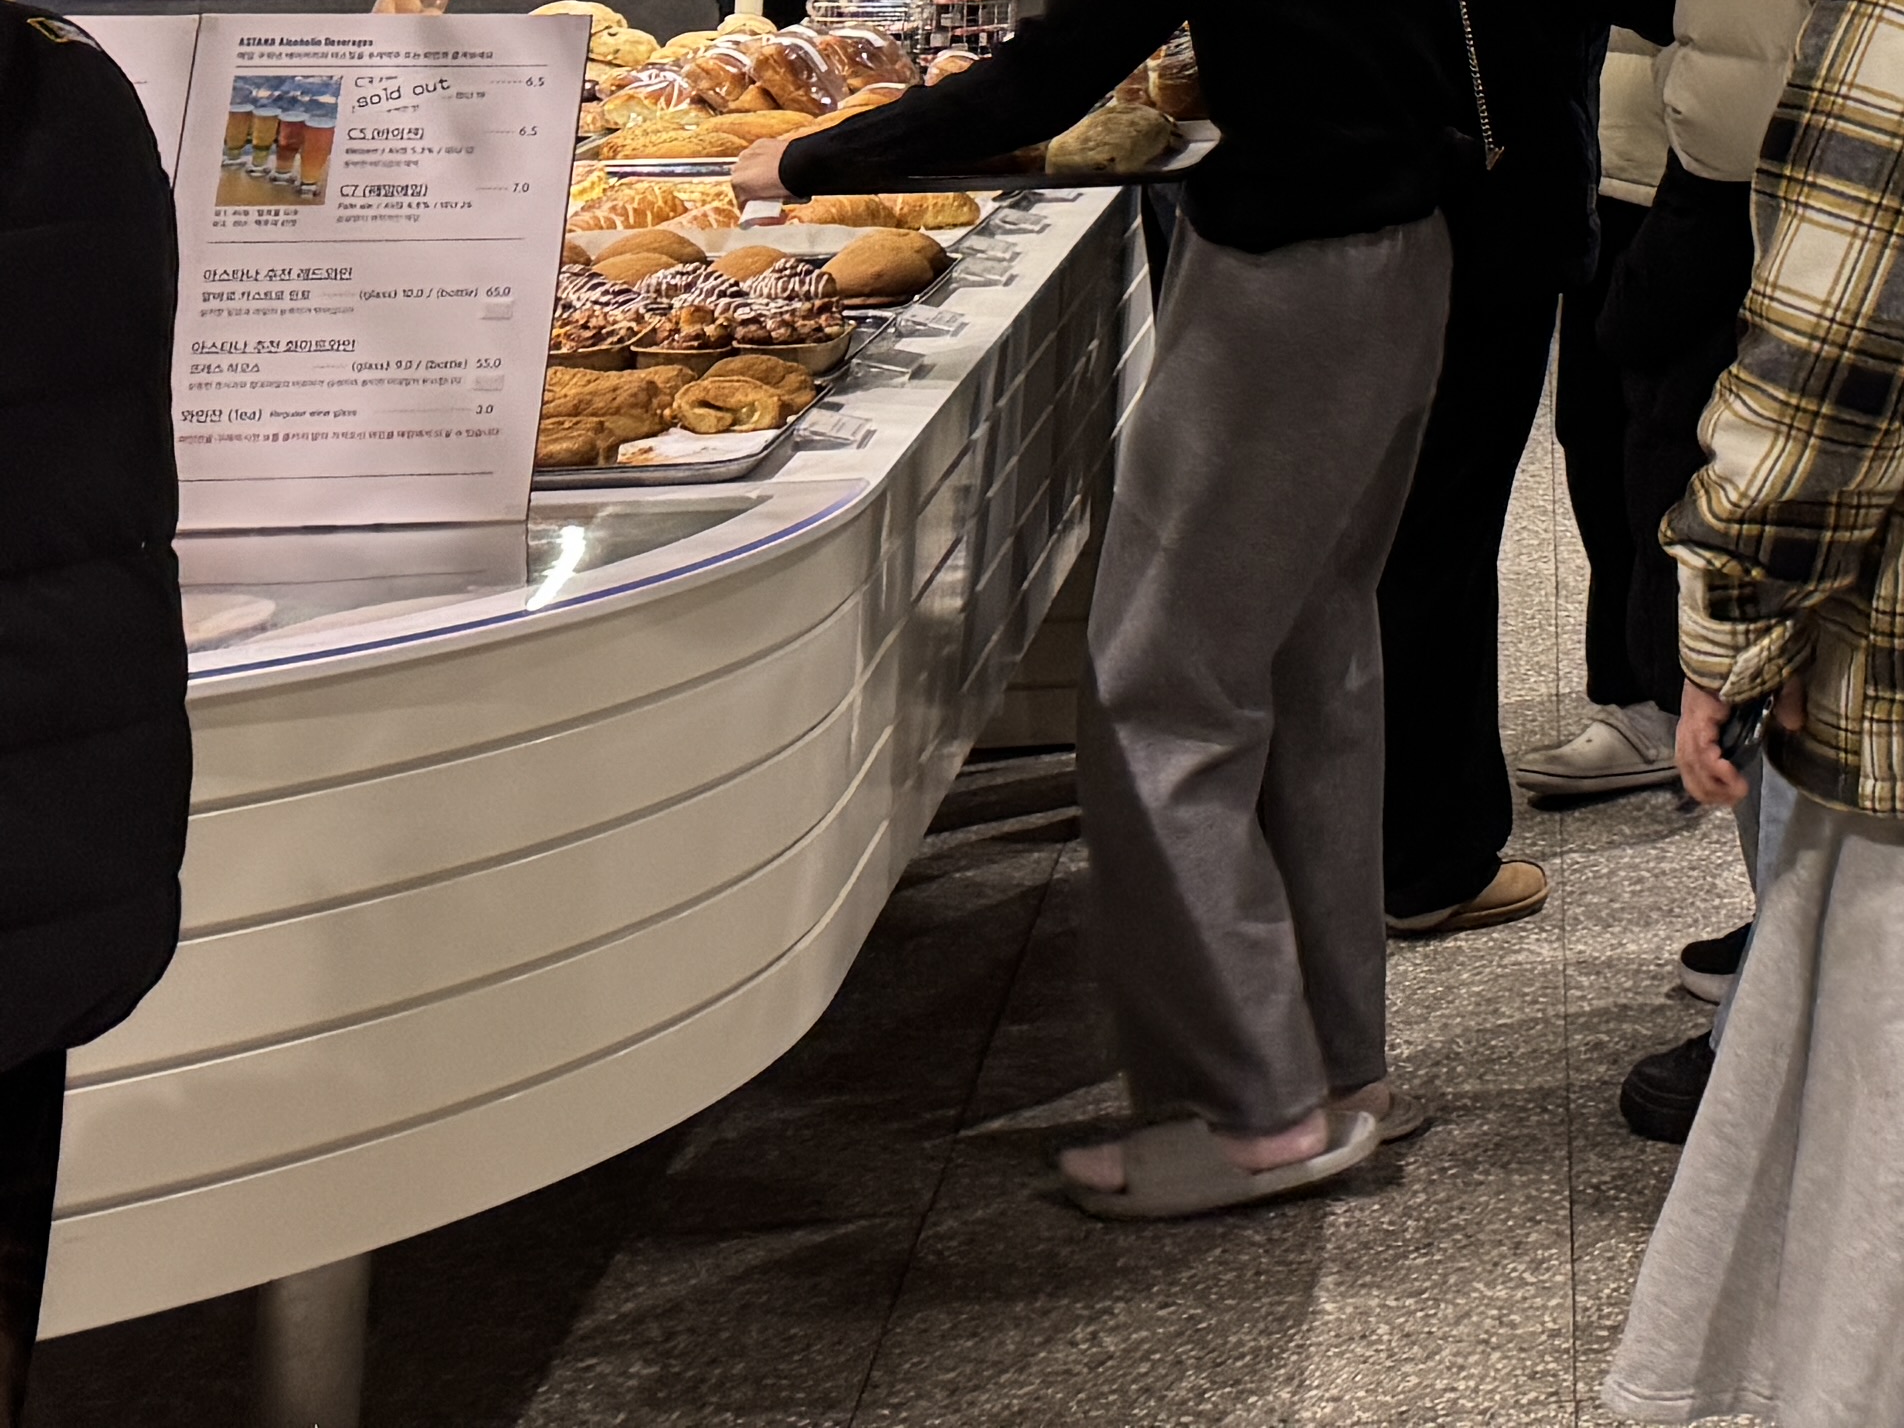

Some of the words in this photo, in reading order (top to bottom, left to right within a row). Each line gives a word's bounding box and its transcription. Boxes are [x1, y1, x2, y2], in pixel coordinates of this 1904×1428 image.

[525, 77, 545, 87] 6.5
[355, 85, 403, 109] sold
[412, 77, 451, 97] out
[519, 126, 538, 136] 6.5
[340, 184, 358, 197] C7
